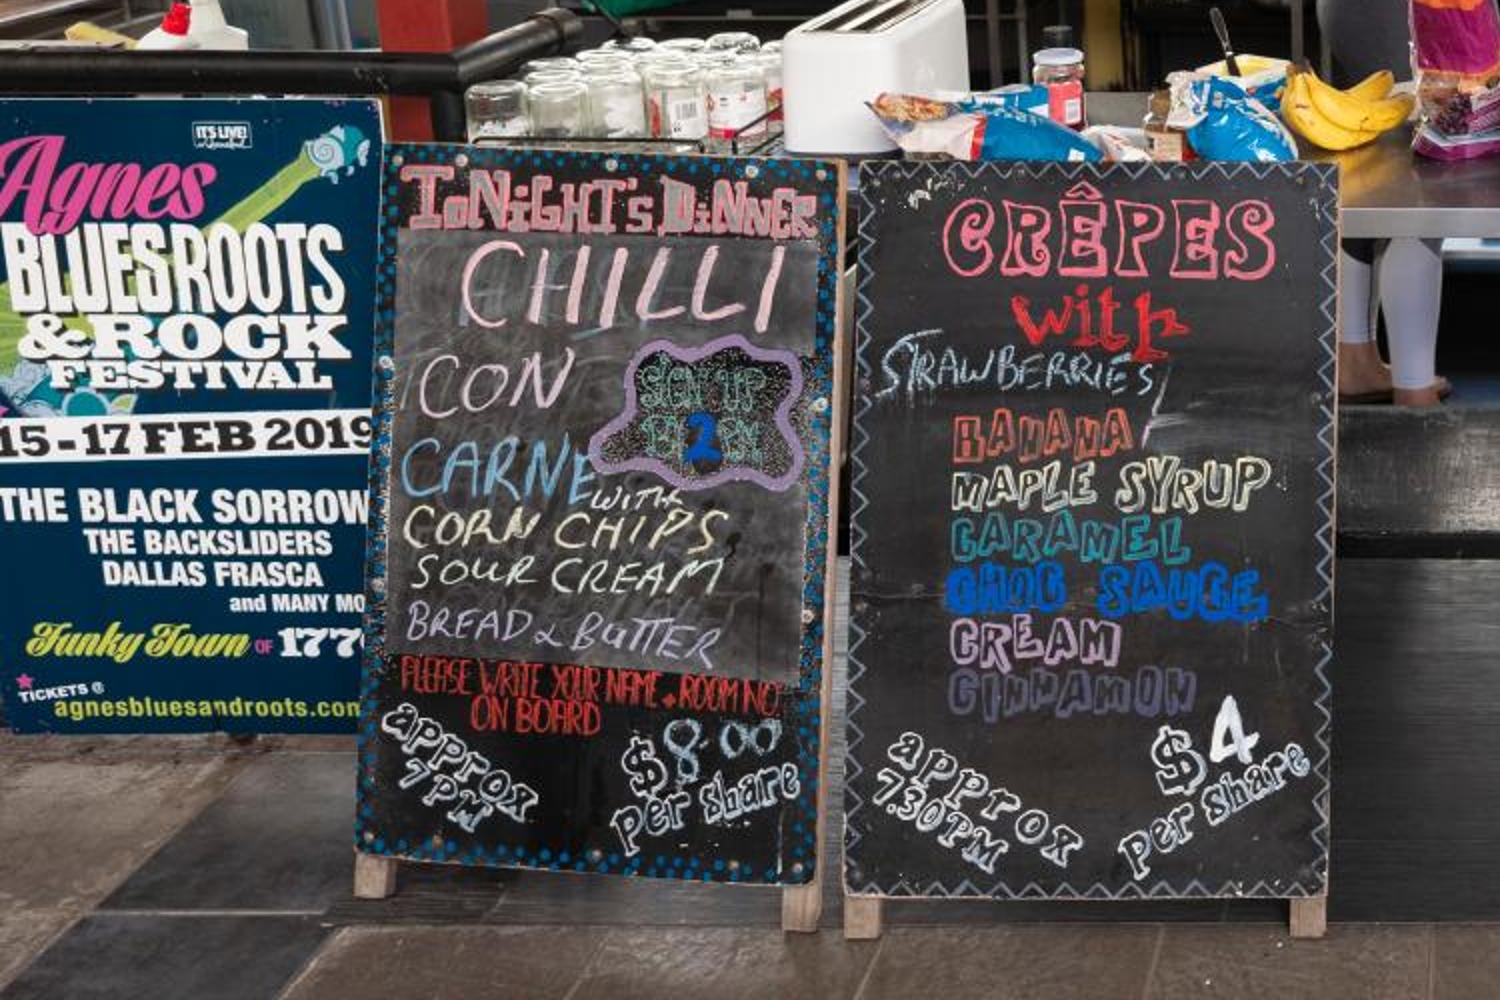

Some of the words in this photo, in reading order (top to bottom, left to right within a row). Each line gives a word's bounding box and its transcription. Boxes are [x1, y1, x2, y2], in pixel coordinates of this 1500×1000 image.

[0, 135, 217, 237] Agnes
[943, 181, 1277, 280] CRÊPES
[461, 240, 785, 334] CHILLI
[88, 313, 352, 360] ROCK
[1011, 284, 1196, 364] with
[50, 359, 333, 389] FESTIVAL
[419, 347, 576, 420] CON
[874, 328, 1154, 399] STRAWBERRIES
[140, 419, 257, 455] FEB
[265, 416, 371, 450] 2019
[400, 432, 598, 505] CARNE
[951, 459, 1099, 511] MAPLE
[1114, 456, 1275, 514] SYRUP
[0, 487, 69, 523] THE
[78, 488, 203, 524] BLACK
[402, 504, 542, 549] CORN
[554, 506, 729, 555] CHIPS
[84, 529, 137, 555] THE
[144, 529, 333, 556] BACKSLIDERS
[949, 508, 1193, 566] CARAMEL
[102, 560, 207, 588] DALLAS
[214, 561, 325, 588] FRASCA
[551, 556, 724, 596] CREAM
[1097, 560, 1271, 623] SAUCE
[229, 595, 267, 612] and
[272, 594, 329, 612] MANY
[406, 600, 534, 641] BREAD
[25, 621, 146, 663] Funky
[948, 613, 1122, 674] CREAM
[18, 684, 89, 704] TICKETS
[401, 654, 474, 696] PLEASE
[479, 657, 546, 698] WRITE
[552, 663, 600, 701] YOUR
[605, 668, 663, 709] NAME
[470, 694, 510, 731] ON
[515, 697, 601, 736] BOARD
